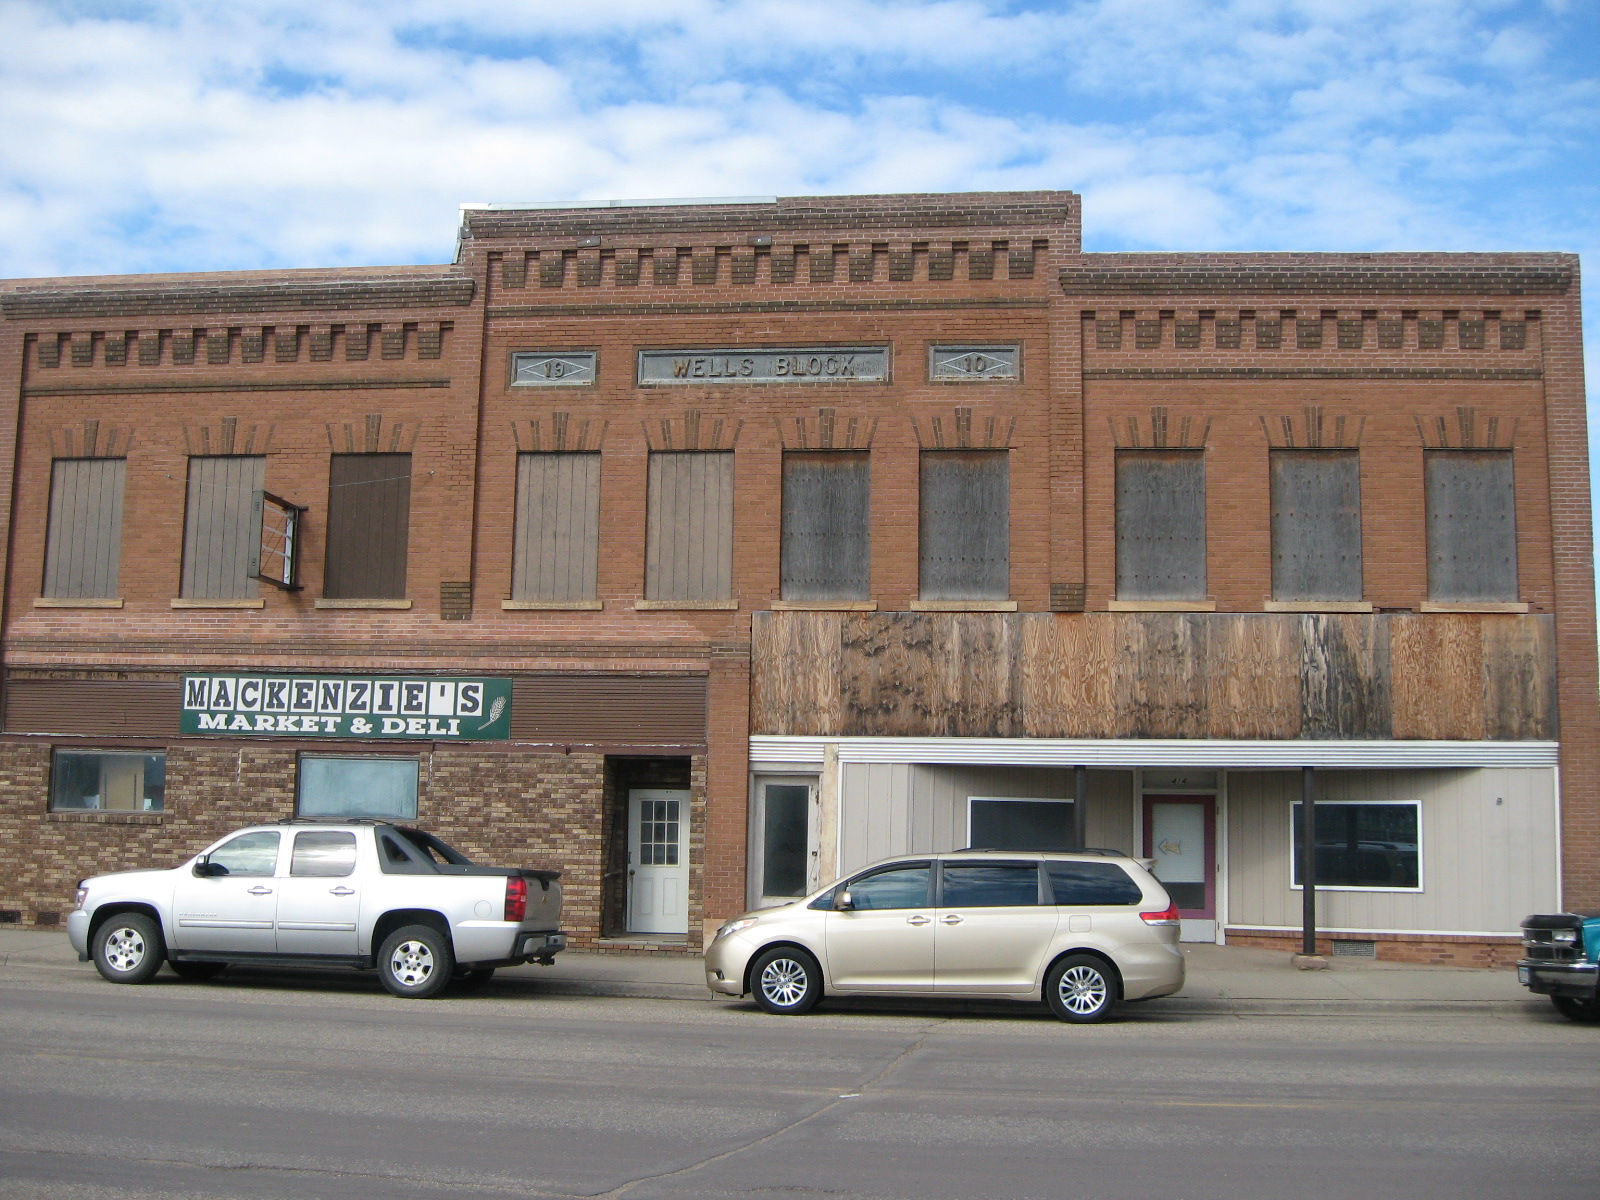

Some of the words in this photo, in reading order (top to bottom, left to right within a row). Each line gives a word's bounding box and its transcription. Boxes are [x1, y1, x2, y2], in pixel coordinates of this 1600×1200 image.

[543, 362, 565, 378] 19
[672, 357, 754, 378] WELLS
[775, 355, 855, 377] BLOCK
[964, 356, 987, 373] 10
[186, 679, 480, 714] MACKENZIE'S
[197, 713, 342, 733] MARKET
[350, 716, 374, 734] &
[381, 717, 461, 736] DELI
